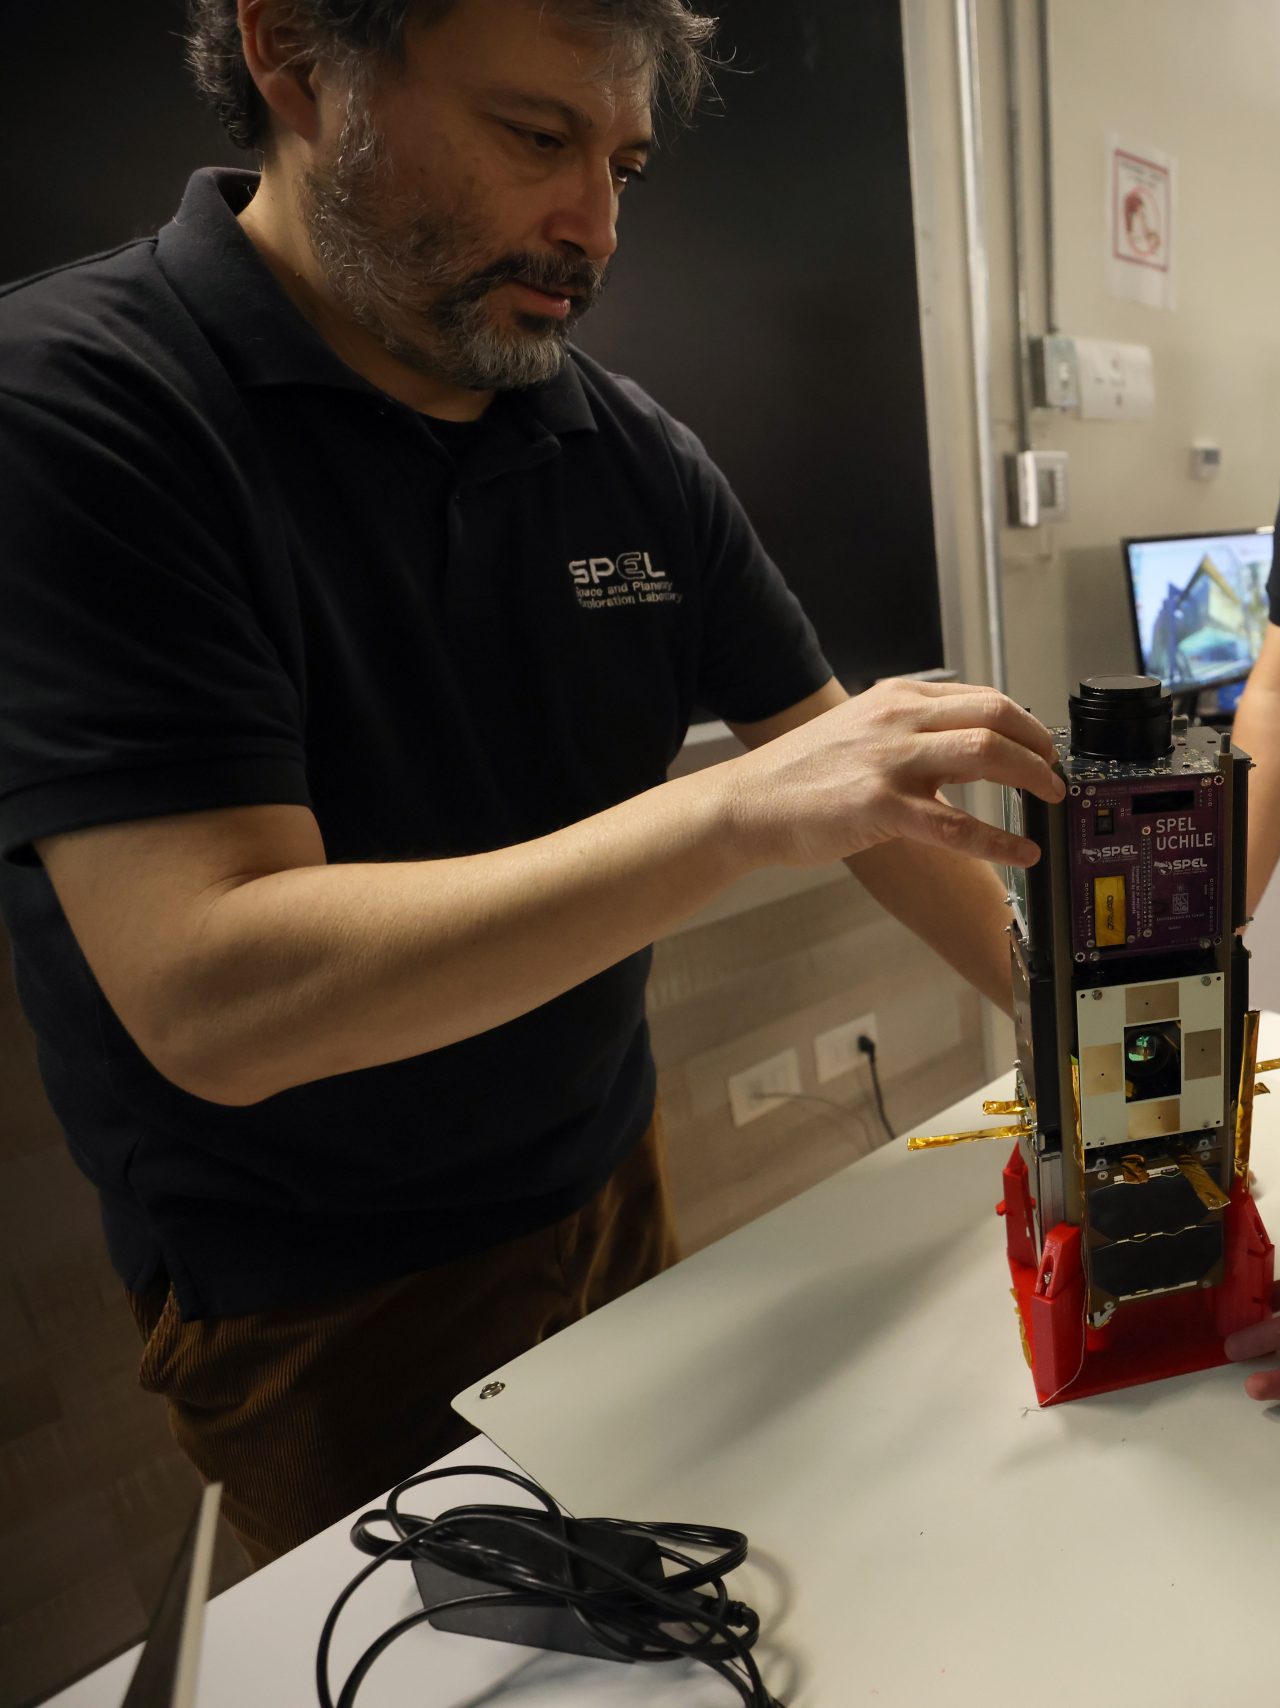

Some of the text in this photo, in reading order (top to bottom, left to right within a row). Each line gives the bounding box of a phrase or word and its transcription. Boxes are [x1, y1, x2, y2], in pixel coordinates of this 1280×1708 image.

[569, 552, 666, 584] SPEL
[607, 582, 629, 595] and
[1156, 817, 1197, 833] SPEL
[1156, 832, 1213, 850] UCHILE
[1101, 845, 1139, 857] SPEL
[1173, 857, 1208, 870] SPEL
